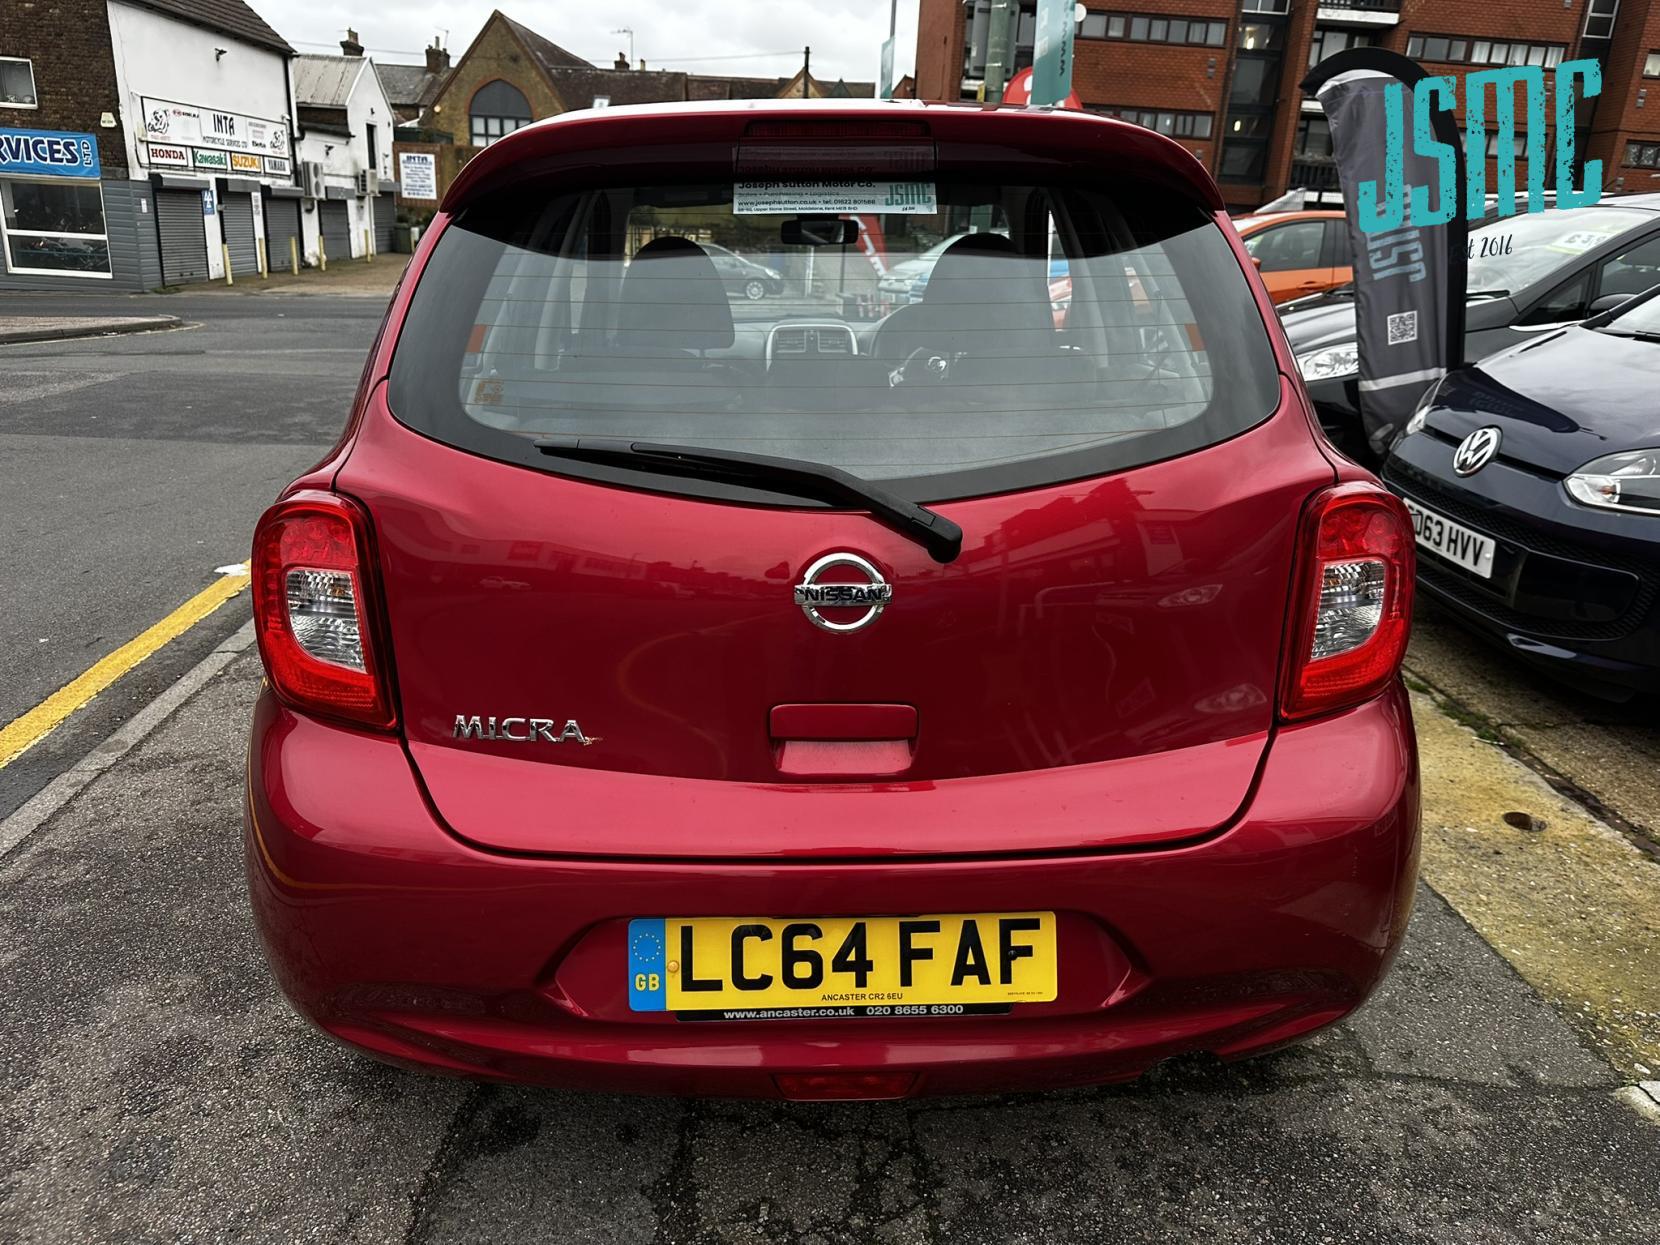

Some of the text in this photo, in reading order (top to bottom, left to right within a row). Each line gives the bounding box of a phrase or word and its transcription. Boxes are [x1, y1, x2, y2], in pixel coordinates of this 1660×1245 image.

[213, 113, 235, 136] INTA
[81, 140, 93, 167] LTD
[151, 148, 185, 160] HONDA
[193, 149, 226, 165] Kawasaki
[232, 155, 260, 169] SUZUKI
[738, 181, 780, 190] Joseph
[885, 182, 932, 206] JSMC
[1446, 526, 1484, 566] HVV
[804, 586, 882, 602] NISSAN
[452, 714, 587, 742] MICRA
[680, 918, 1041, 992] LC64 FAF
[635, 973, 660, 992] GB
[821, 992, 903, 1001] ANCASTER CR2 6EU
[723, 1004, 964, 1019] www.ancaster.co.uk 020 8655 6300
